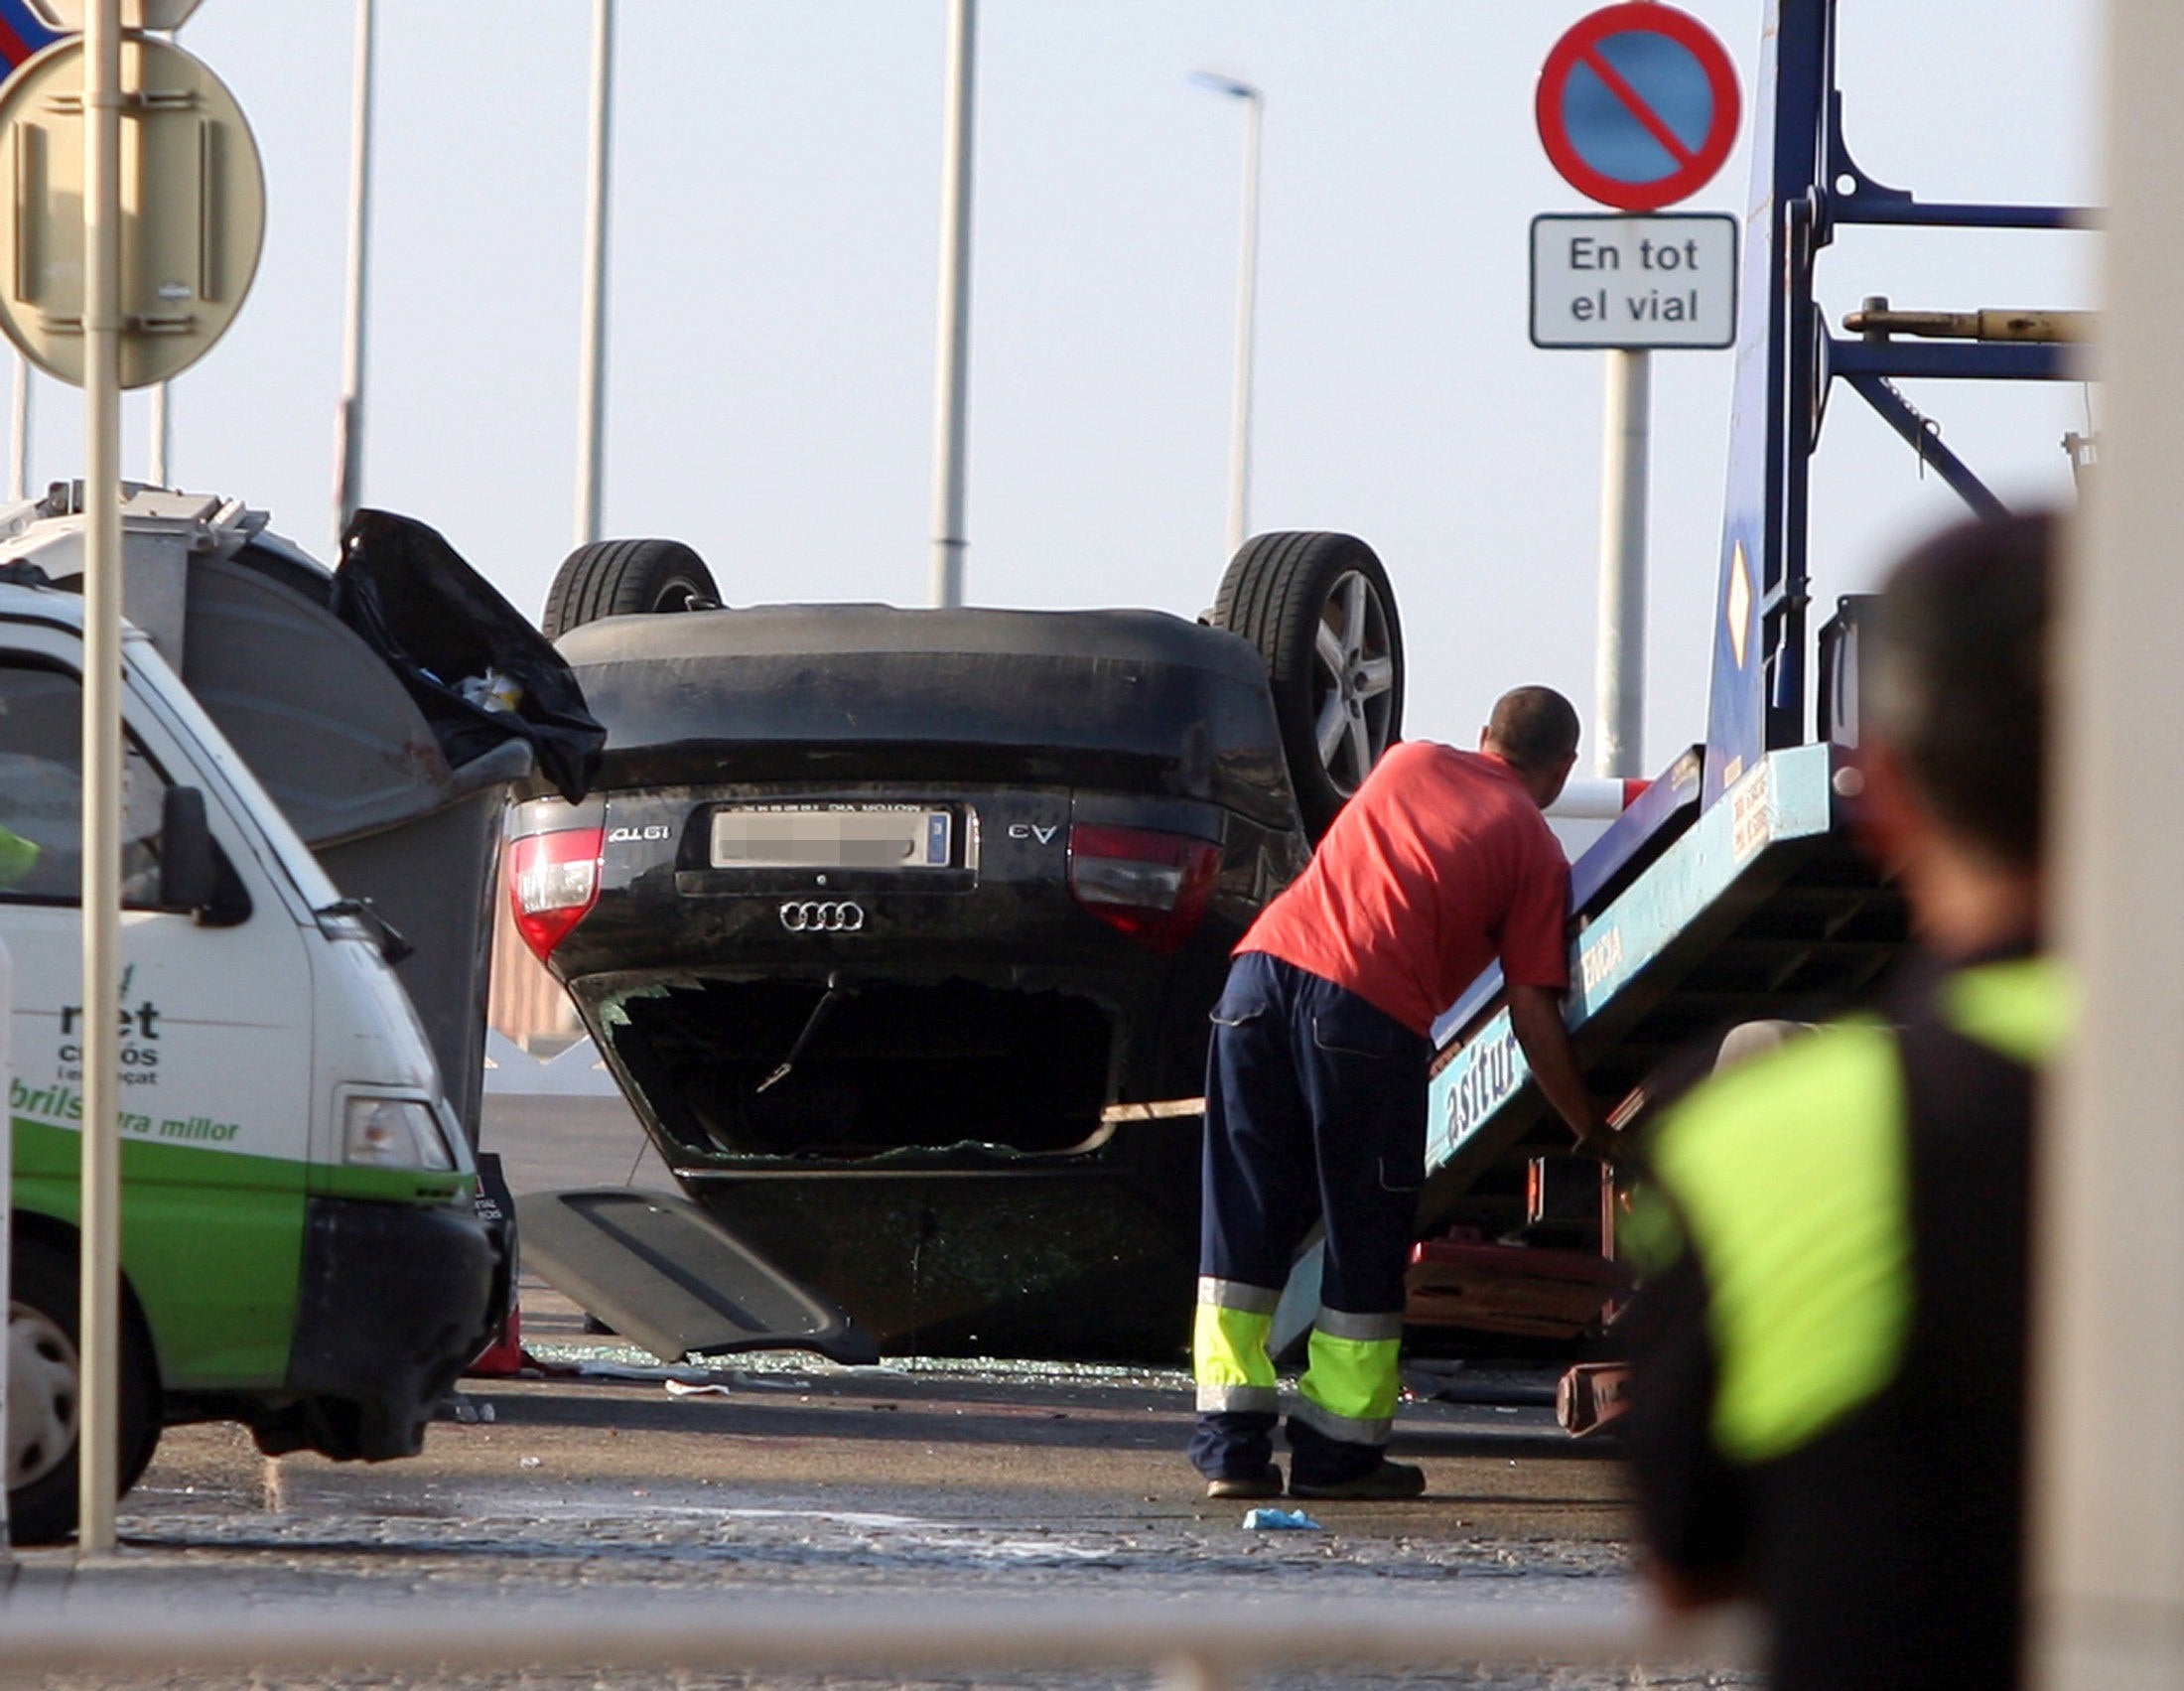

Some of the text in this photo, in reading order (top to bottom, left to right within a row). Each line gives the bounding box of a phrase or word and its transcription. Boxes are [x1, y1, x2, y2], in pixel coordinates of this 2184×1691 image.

[1570, 237, 1700, 271] En tot
[1571, 289, 1698, 322] el vial
[159, 1115, 240, 1141] millor
